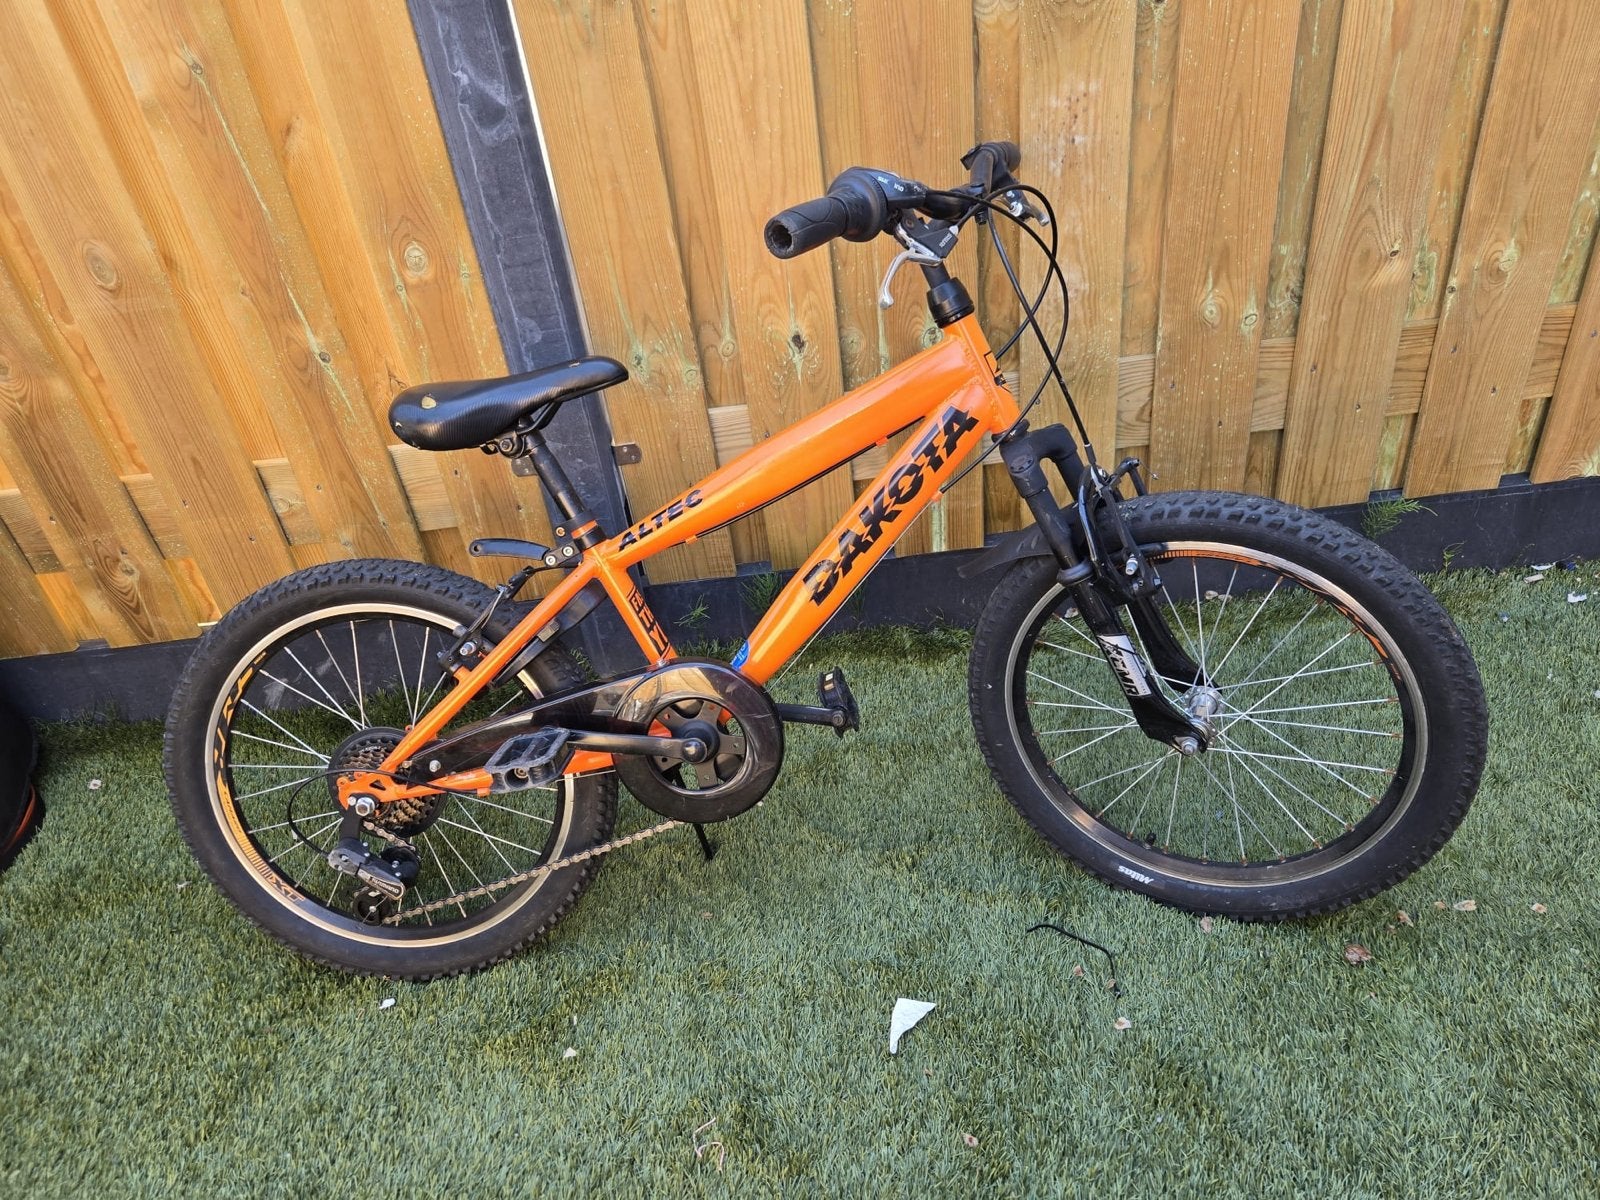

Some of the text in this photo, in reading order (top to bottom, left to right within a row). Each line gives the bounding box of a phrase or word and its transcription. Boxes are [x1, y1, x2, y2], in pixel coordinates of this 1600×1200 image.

[618, 489, 703, 552] ALTEC
[803, 405, 980, 606] DAKOTA
[1117, 865, 1155, 884] Mitas
